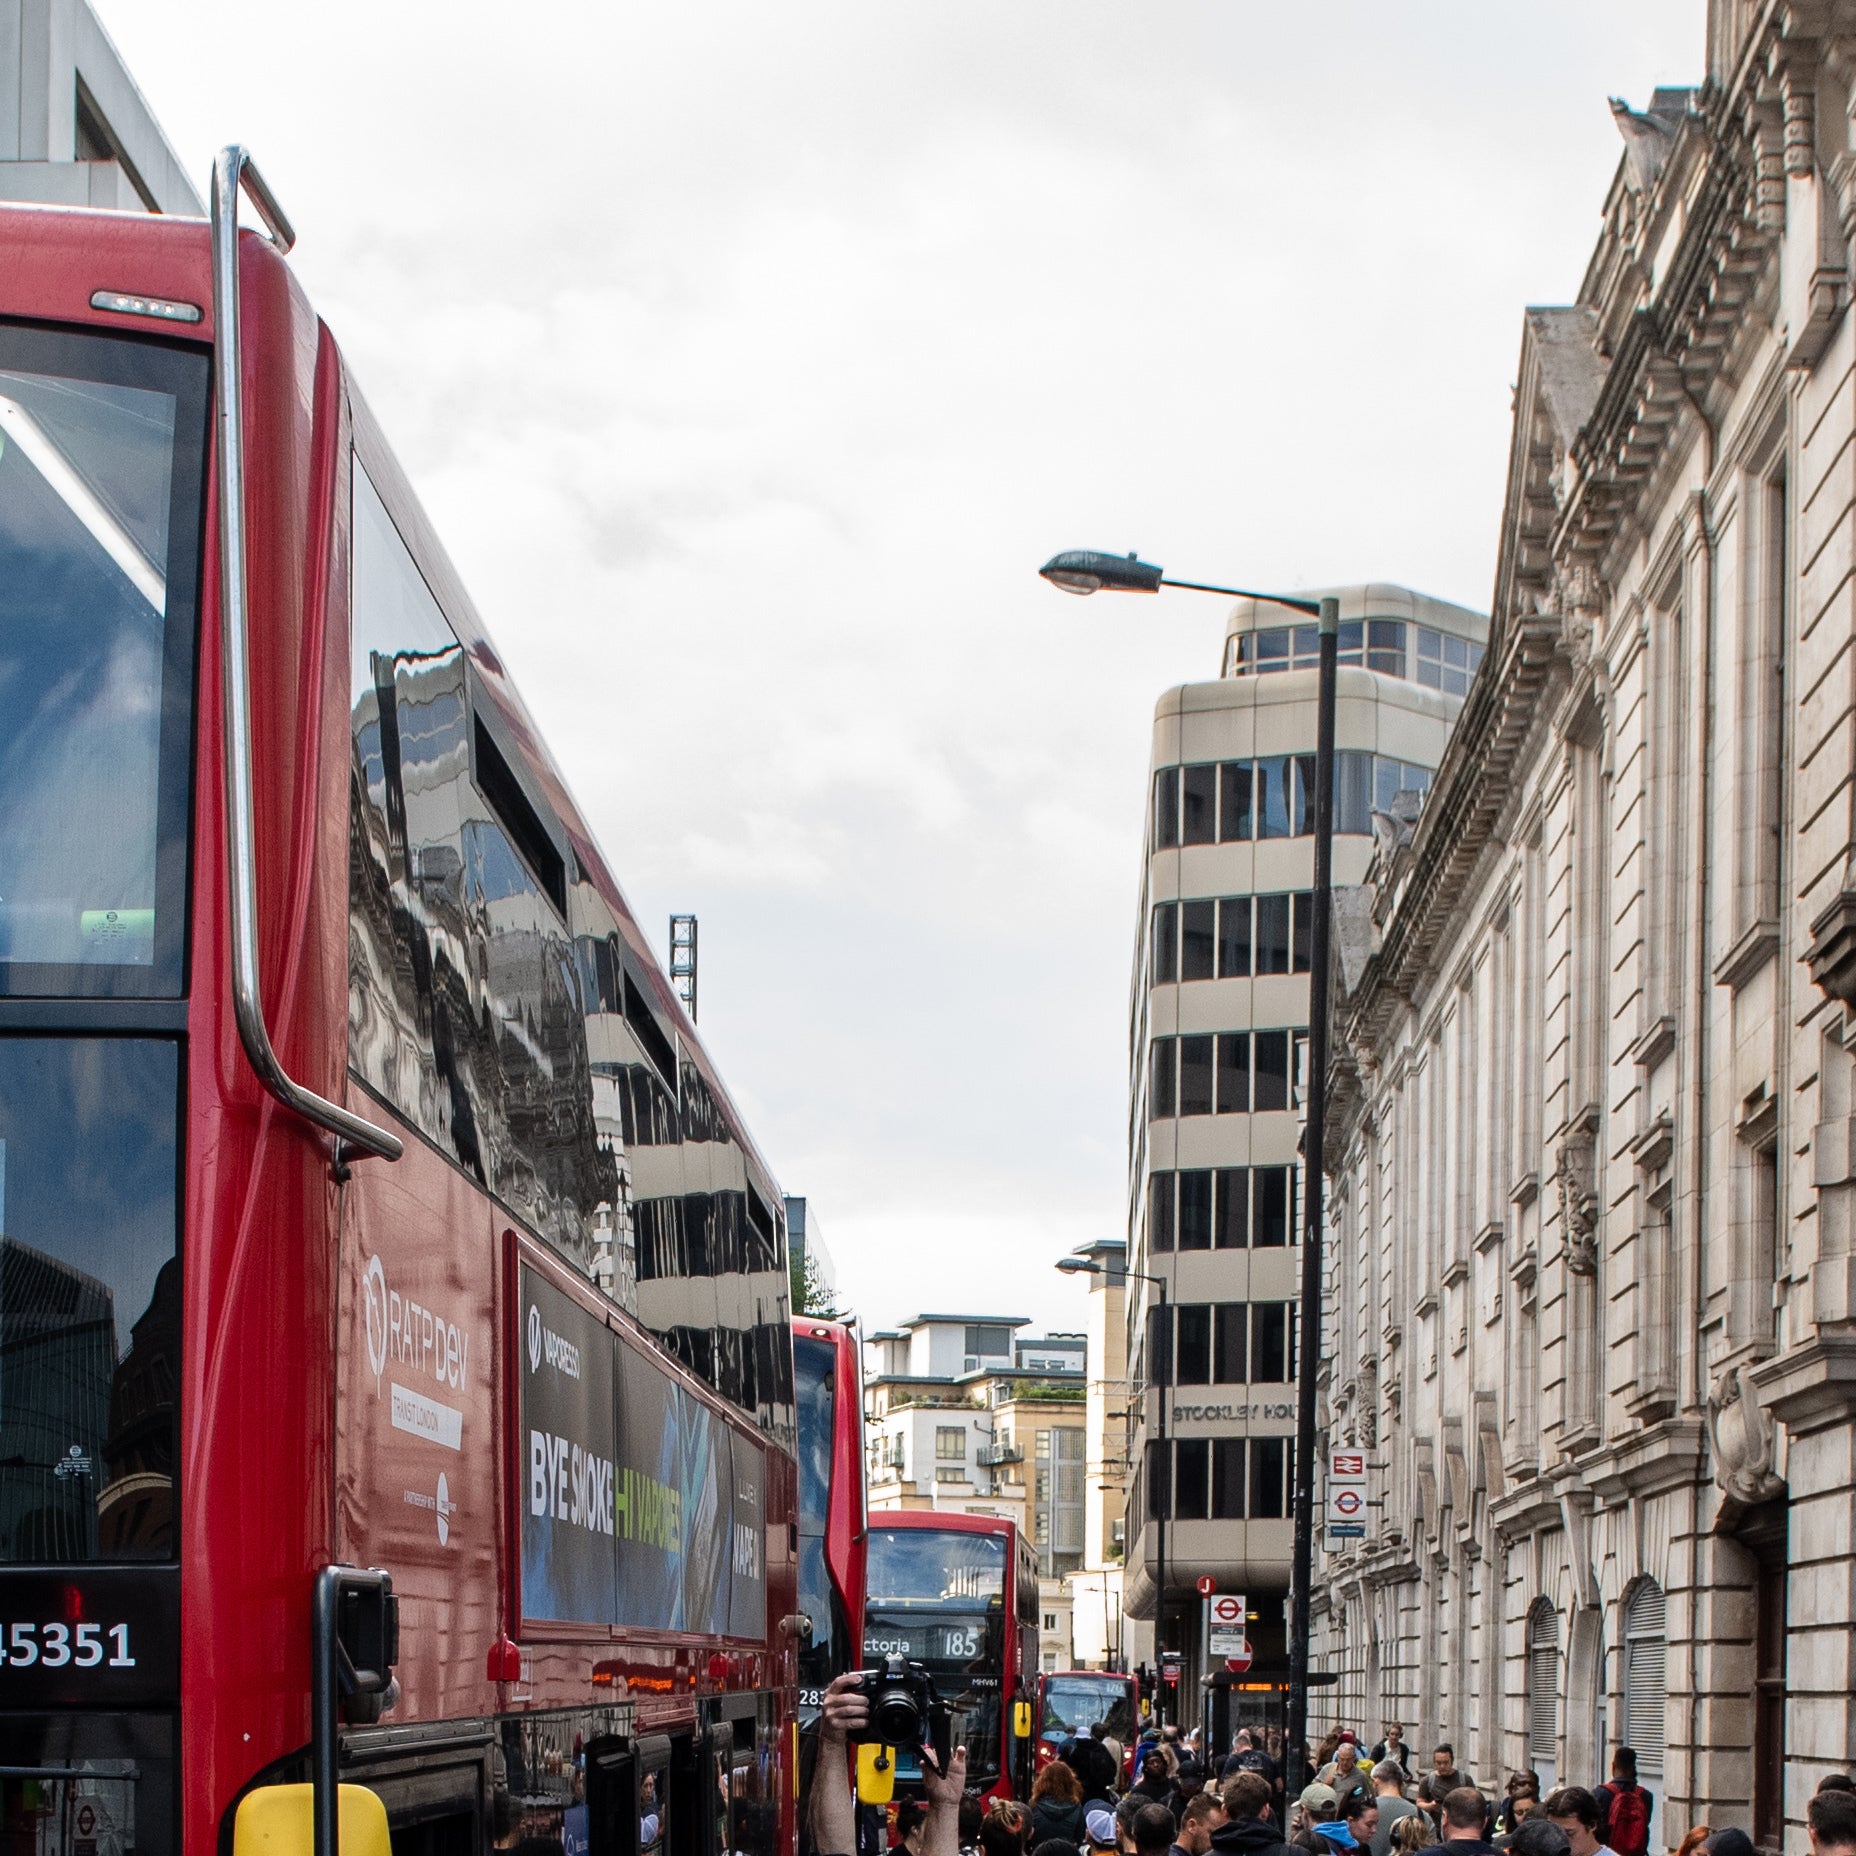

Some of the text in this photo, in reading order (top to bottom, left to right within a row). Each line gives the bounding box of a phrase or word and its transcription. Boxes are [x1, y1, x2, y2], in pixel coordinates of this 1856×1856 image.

[390, 1289, 433, 1373] RATP
[530, 1429, 569, 1521] BYE
[571, 1442, 614, 1536] SMOKE
[615, 1465, 634, 1540] HI
[1200, 1579, 1210, 1593] J
[945, 1632, 977, 1656] 185
